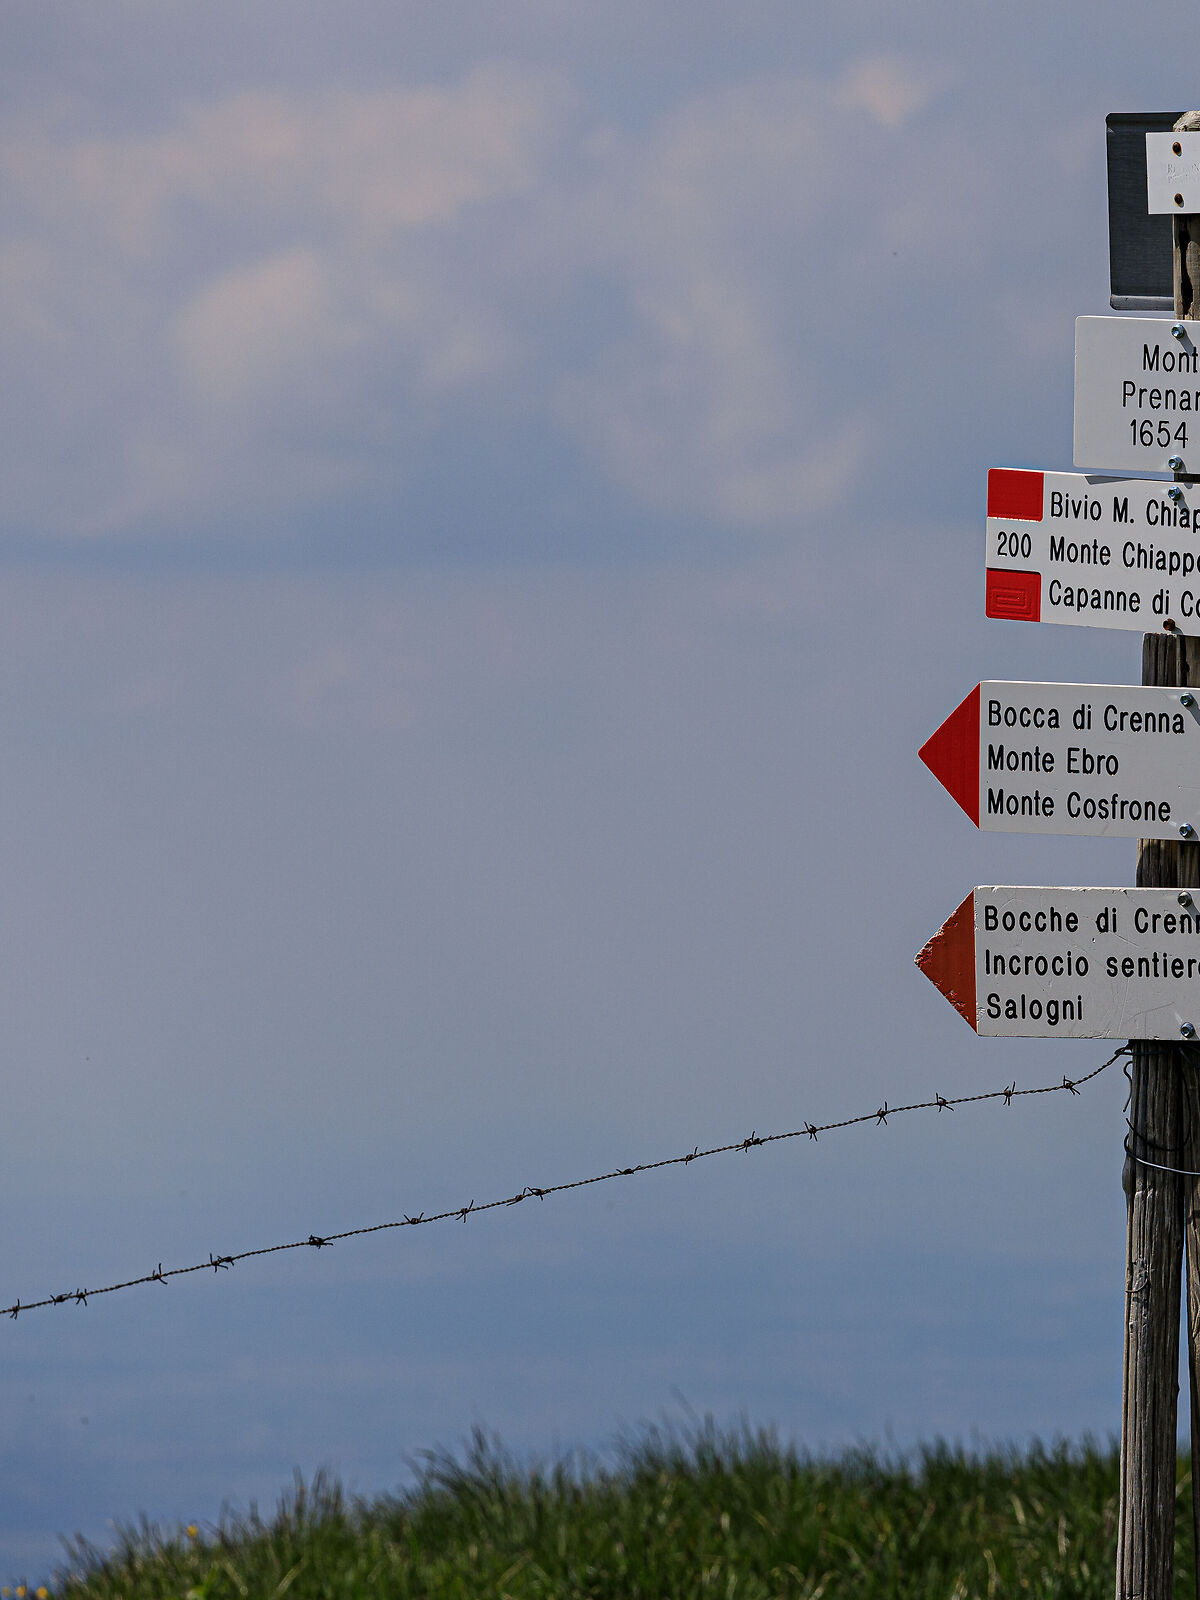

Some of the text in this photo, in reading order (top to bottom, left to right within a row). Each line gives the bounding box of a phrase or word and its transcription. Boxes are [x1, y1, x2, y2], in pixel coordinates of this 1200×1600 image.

[1131, 419, 1188, 448] 1654
[1051, 492, 1101, 521] Bivio
[1113, 497, 1134, 523] M.
[998, 532, 1031, 558] 200
[1050, 536, 1110, 565] Monte
[1049, 580, 1140, 612] Capanne
[1152, 589, 1169, 615] di
[989, 700, 1060, 729] Bocca
[1073, 704, 1091, 730] di
[1104, 704, 1185, 734] Crenna
[988, 744, 1054, 773] Monte
[1067, 747, 1118, 775] Ebro
[988, 788, 1054, 817] Monte
[1067, 792, 1170, 822] Cosfrone
[985, 905, 1078, 932] Bocche
[1095, 907, 1117, 934] di
[986, 949, 1088, 976] Incrocio
[987, 993, 1082, 1026] Salogni
